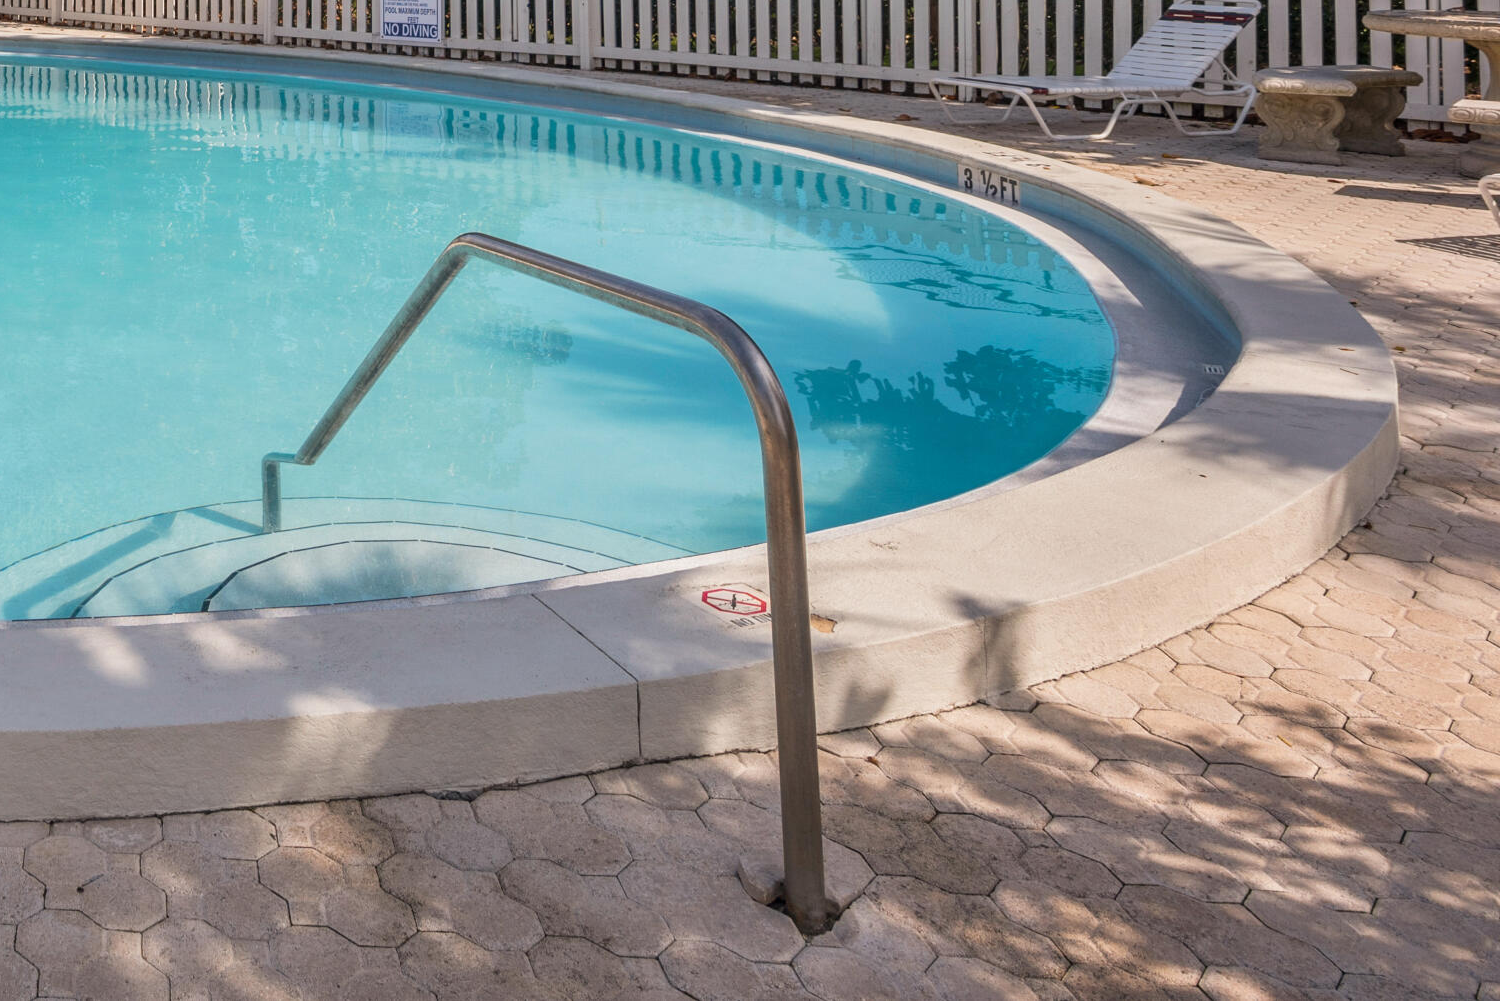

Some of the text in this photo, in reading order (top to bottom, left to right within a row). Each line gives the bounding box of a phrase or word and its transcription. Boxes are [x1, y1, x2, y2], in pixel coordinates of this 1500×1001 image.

[384, 23, 438, 38] NO DIVING
[964, 168, 973, 189] 3
